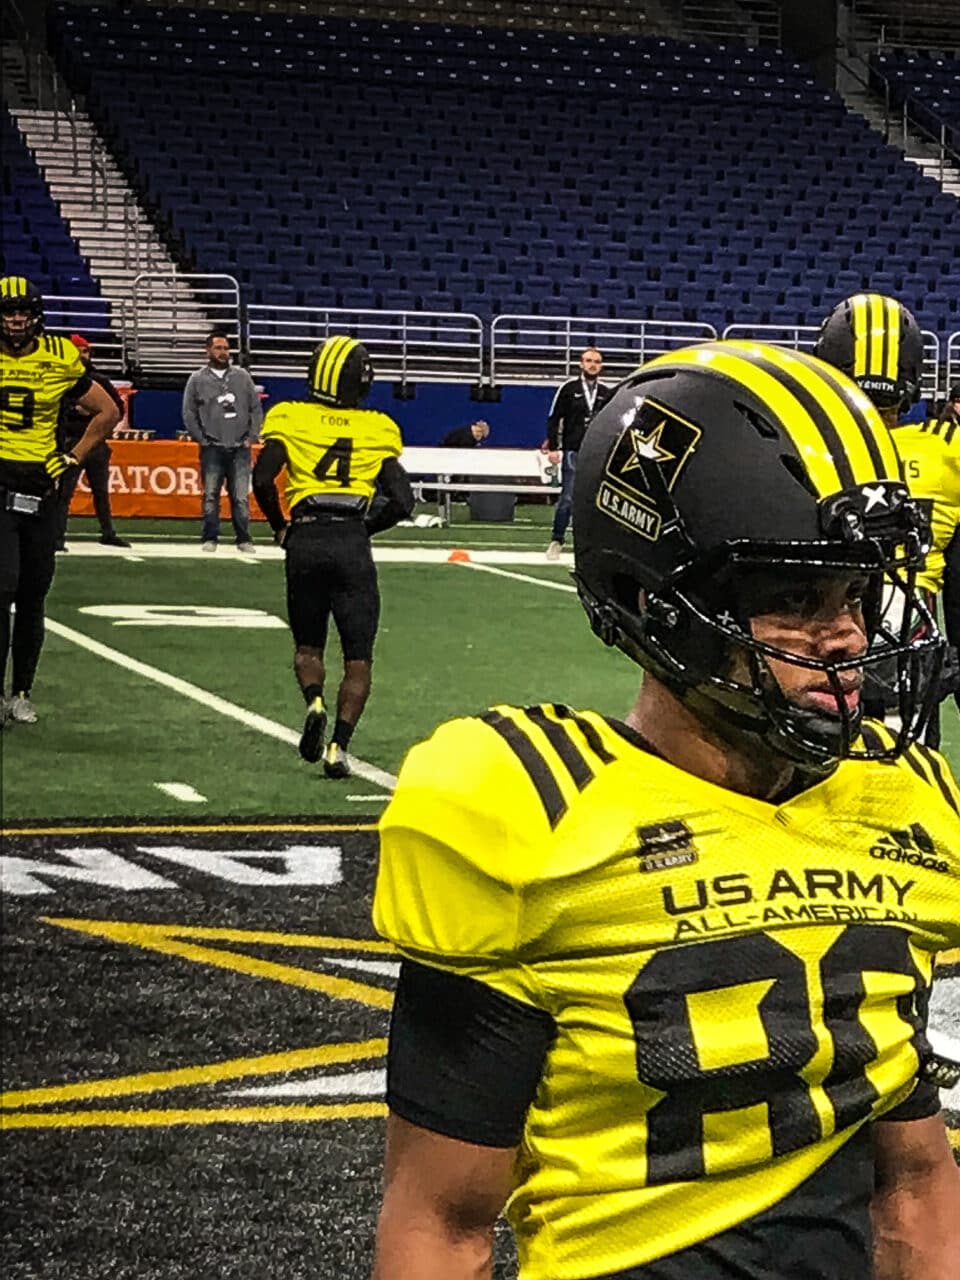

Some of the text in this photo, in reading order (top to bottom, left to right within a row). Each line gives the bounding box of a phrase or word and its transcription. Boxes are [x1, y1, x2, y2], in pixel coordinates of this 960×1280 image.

[312, 437, 357, 488] 4
[868, 845, 949, 874] adidas
[767, 869, 916, 906] ARMY
[672, 904, 918, 941] ALL-AMERICAN
